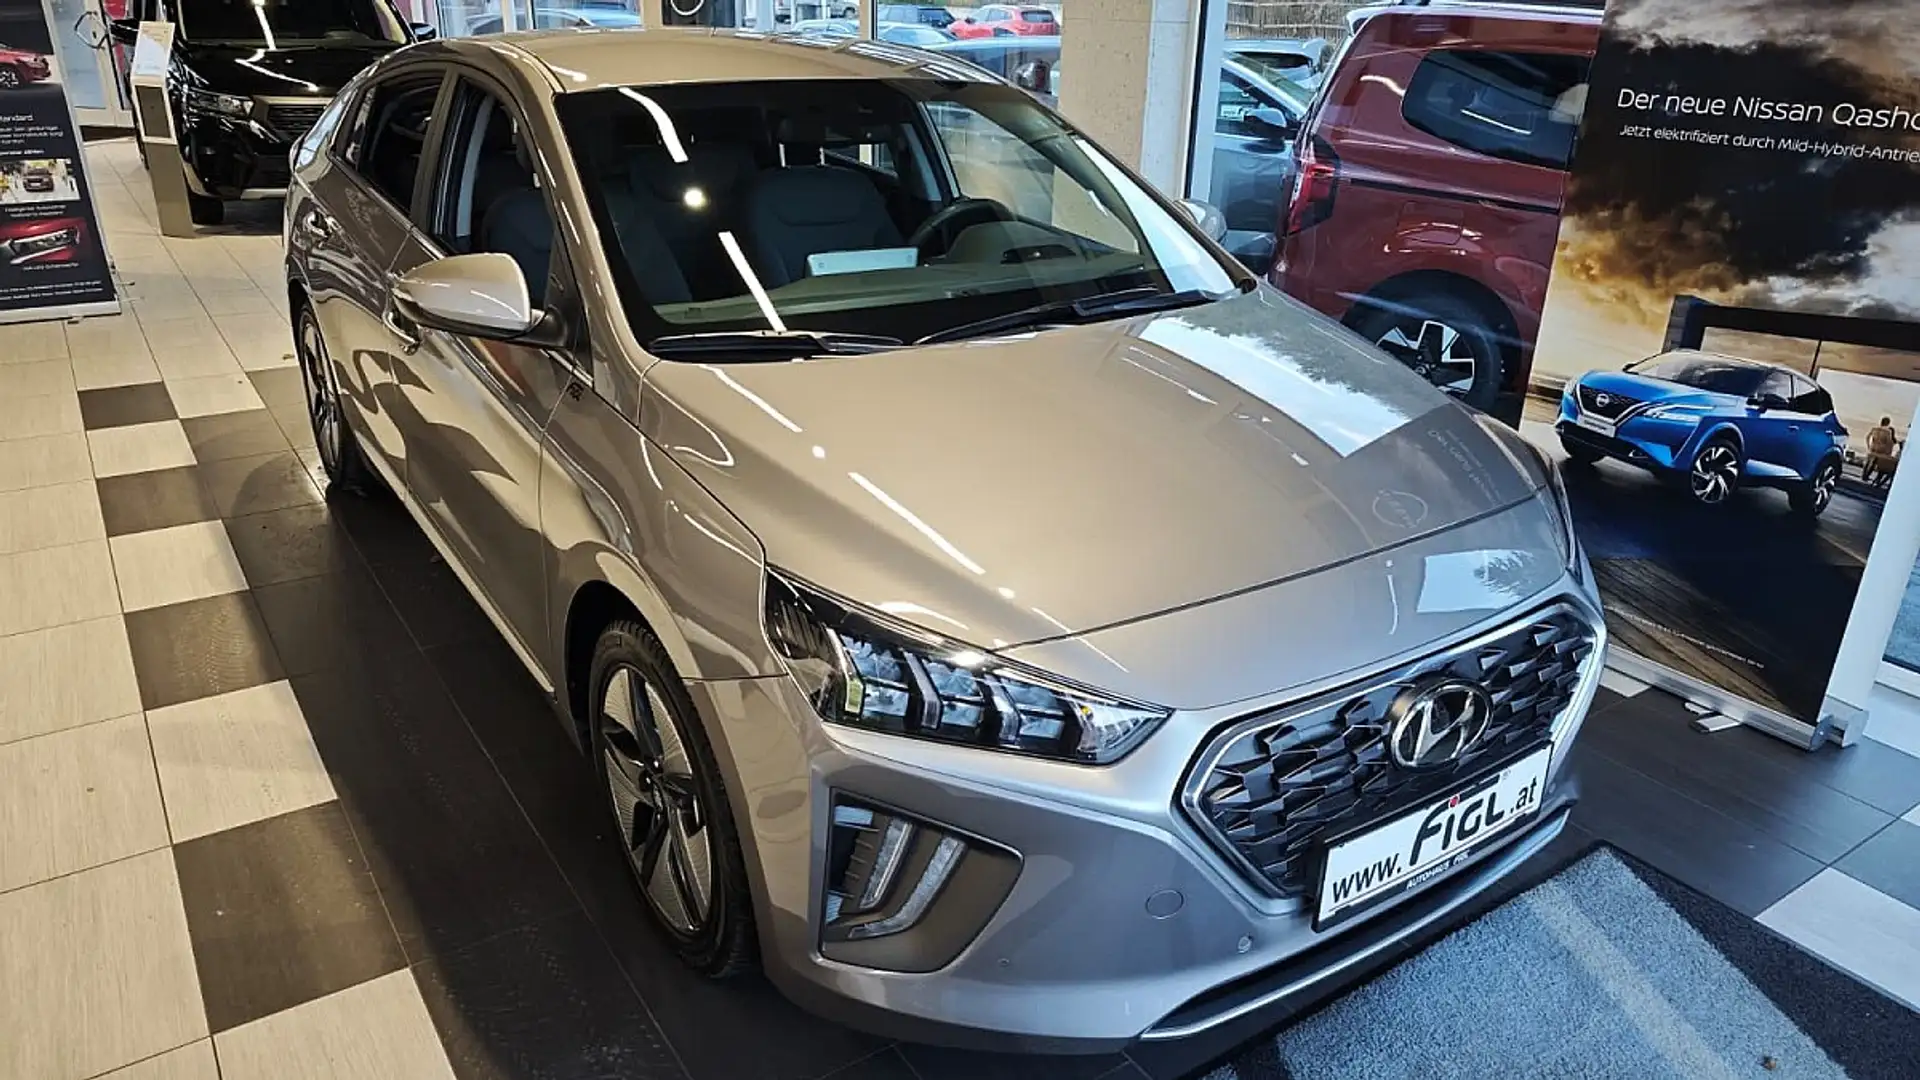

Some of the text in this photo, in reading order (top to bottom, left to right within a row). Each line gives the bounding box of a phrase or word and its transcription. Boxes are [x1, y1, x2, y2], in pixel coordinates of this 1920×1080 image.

[1617, 88, 1660, 110] Der
[1665, 96, 1726, 115] neue
[1733, 96, 1823, 123] Nissan
[1620, 125, 1920, 163] Jetzt elektrifiziert durch Mild-Hybrid-Antrie
